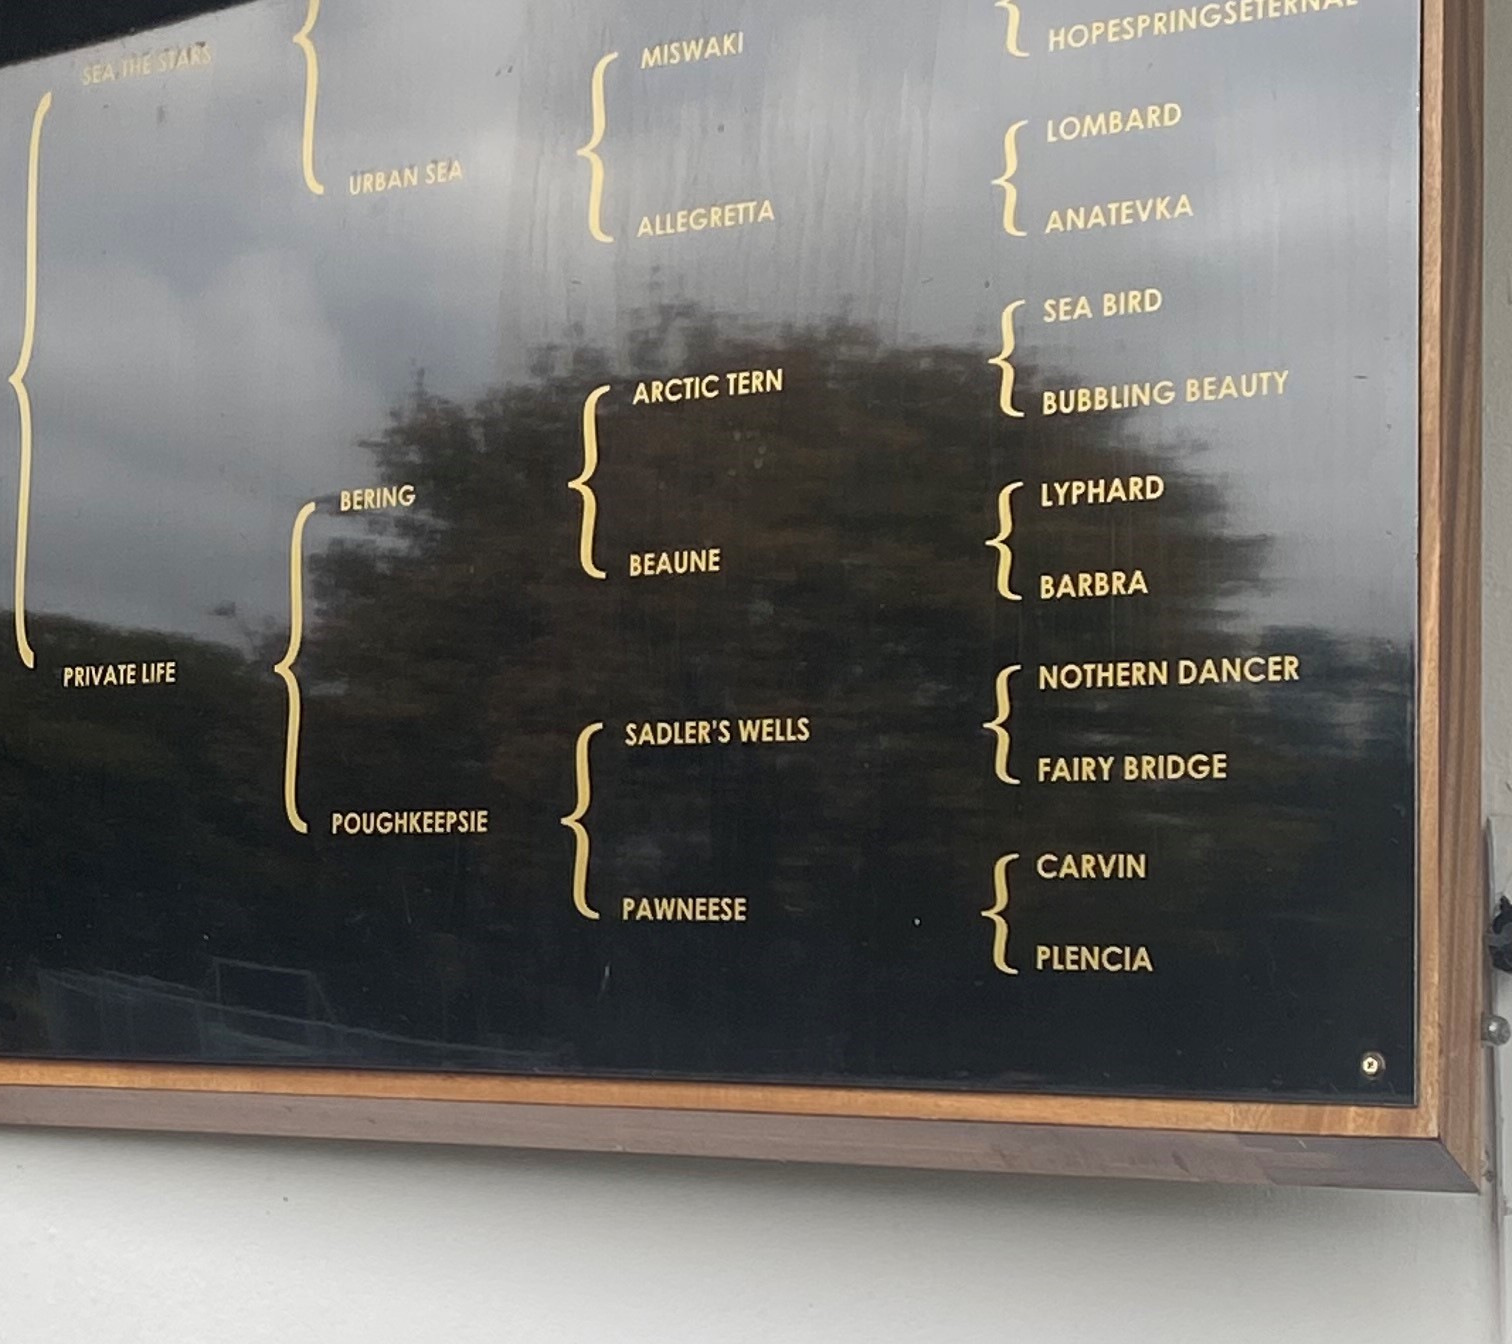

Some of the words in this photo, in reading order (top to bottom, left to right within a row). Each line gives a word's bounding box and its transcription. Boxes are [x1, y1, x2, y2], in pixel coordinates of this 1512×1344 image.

[641, 34, 743, 69] MISWAKI
[82, 62, 116, 86] SEA
[120, 53, 152, 78] THE
[1048, 102, 1181, 143] LOMBARD
[350, 164, 419, 194] URBAN
[425, 160, 463, 186] SEA
[637, 200, 774, 236] ALLEGRETTA
[1046, 195, 1192, 233] ANATEVKA
[1043, 296, 1092, 322] SEA
[1103, 288, 1161, 316] BIRD
[634, 374, 720, 404] ARCTIC
[727, 370, 784, 394] TERN
[1041, 380, 1176, 416] BUBBLING
[1185, 370, 1288, 402] BEAUTY
[340, 485, 414, 512] BERING
[1041, 476, 1164, 507] LYPHARD
[629, 548, 720, 576] BEAUNE
[1040, 570, 1147, 598] BARBRA
[64, 664, 136, 687] PRIVATE
[140, 661, 174, 685] LIFE
[1038, 661, 1168, 688] NOTHERN
[1176, 655, 1298, 685] DANCER
[625, 720, 731, 746] SADLER'S
[737, 717, 810, 742] WELLS
[1037, 756, 1113, 781] FAIRY
[1123, 754, 1226, 780] BRIDGE
[332, 810, 488, 835] POUGHKEEPSIE
[1037, 853, 1146, 878] CARVIN
[621, 897, 746, 921] PAWNEESE
[1035, 945, 1152, 971] PLENCIA
